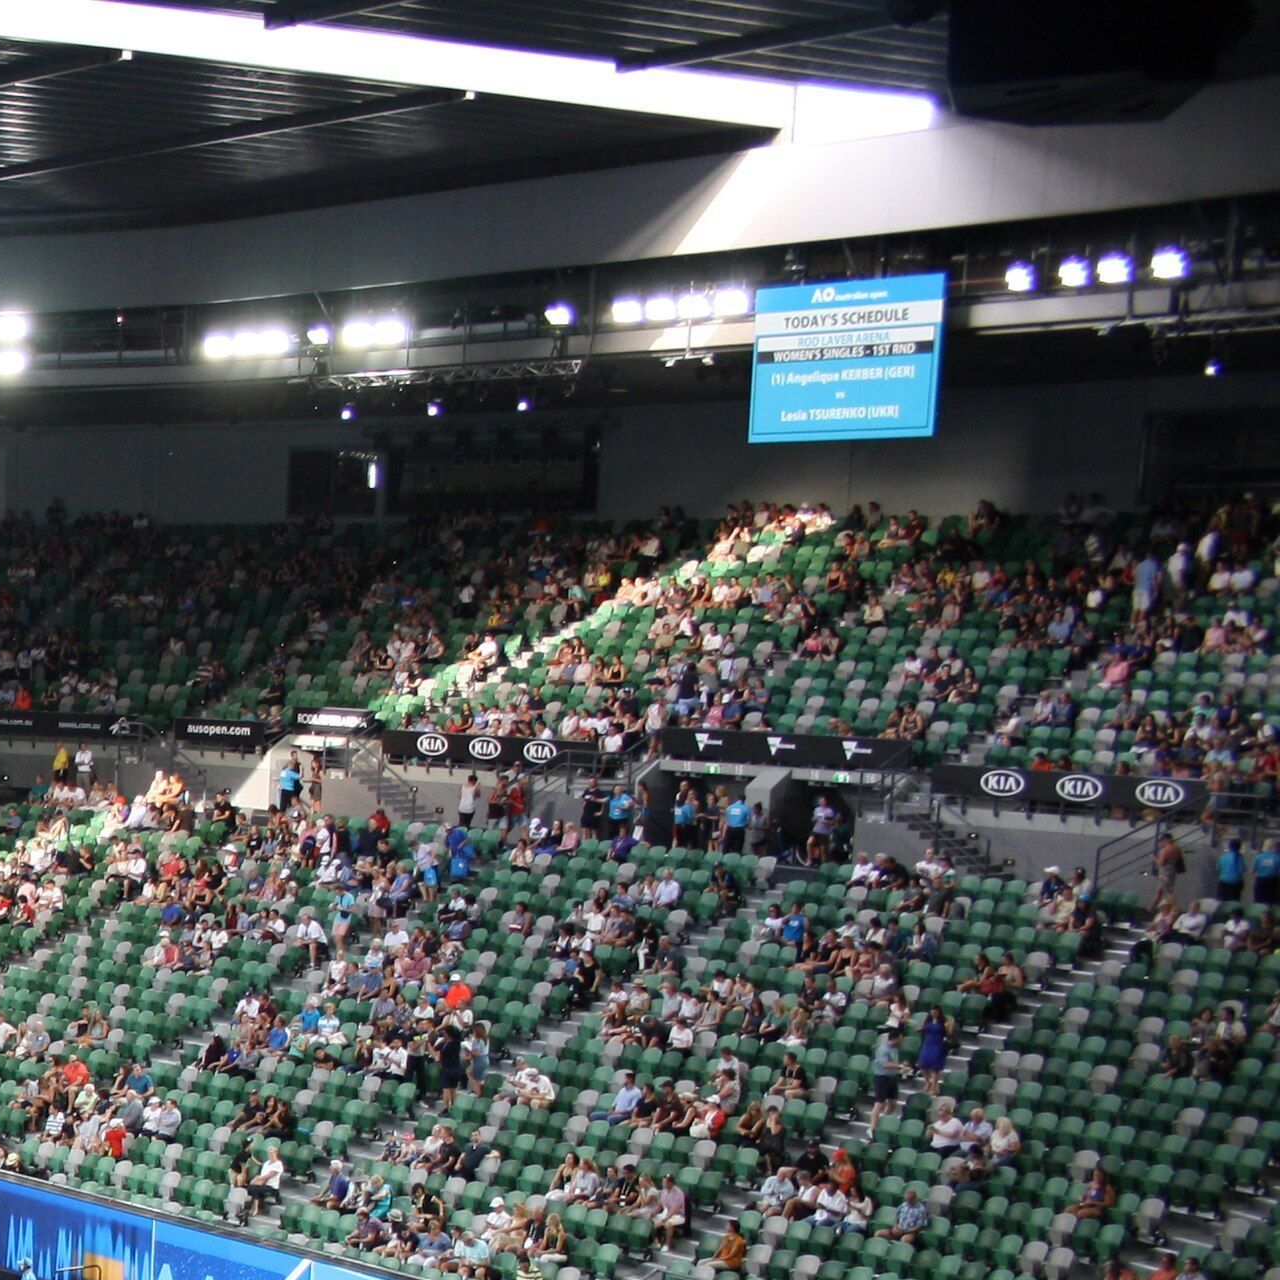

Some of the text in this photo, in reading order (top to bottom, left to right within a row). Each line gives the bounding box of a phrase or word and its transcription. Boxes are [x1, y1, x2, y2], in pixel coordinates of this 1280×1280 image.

[810, 286, 836, 304] AO
[783, 307, 910, 330] TODAY'S SCHEDULE
[797, 331, 890, 348] ROD LAVER ARENA
[773, 348, 822, 363] WOMEN'S
[822, 345, 865, 359] SINGLES
[871, 344, 890, 356] 1ST
[892, 342, 917, 354] RND
[786, 371, 840, 386] Angelique
[841, 367, 883, 381] KERBER
[835, 390, 846, 399] vs
[781, 409, 808, 422] Lesia
[809, 406, 867, 421] TSURENKO
[186, 723, 251, 737] ausopen.com
[421, 738, 443, 751] KIA
[474, 742, 496, 755] KIA
[529, 745, 551, 759] KIA
[987, 776, 1017, 790] KIA
[1063, 781, 1094, 796] KIA
[1143, 786, 1174, 802] KIA
